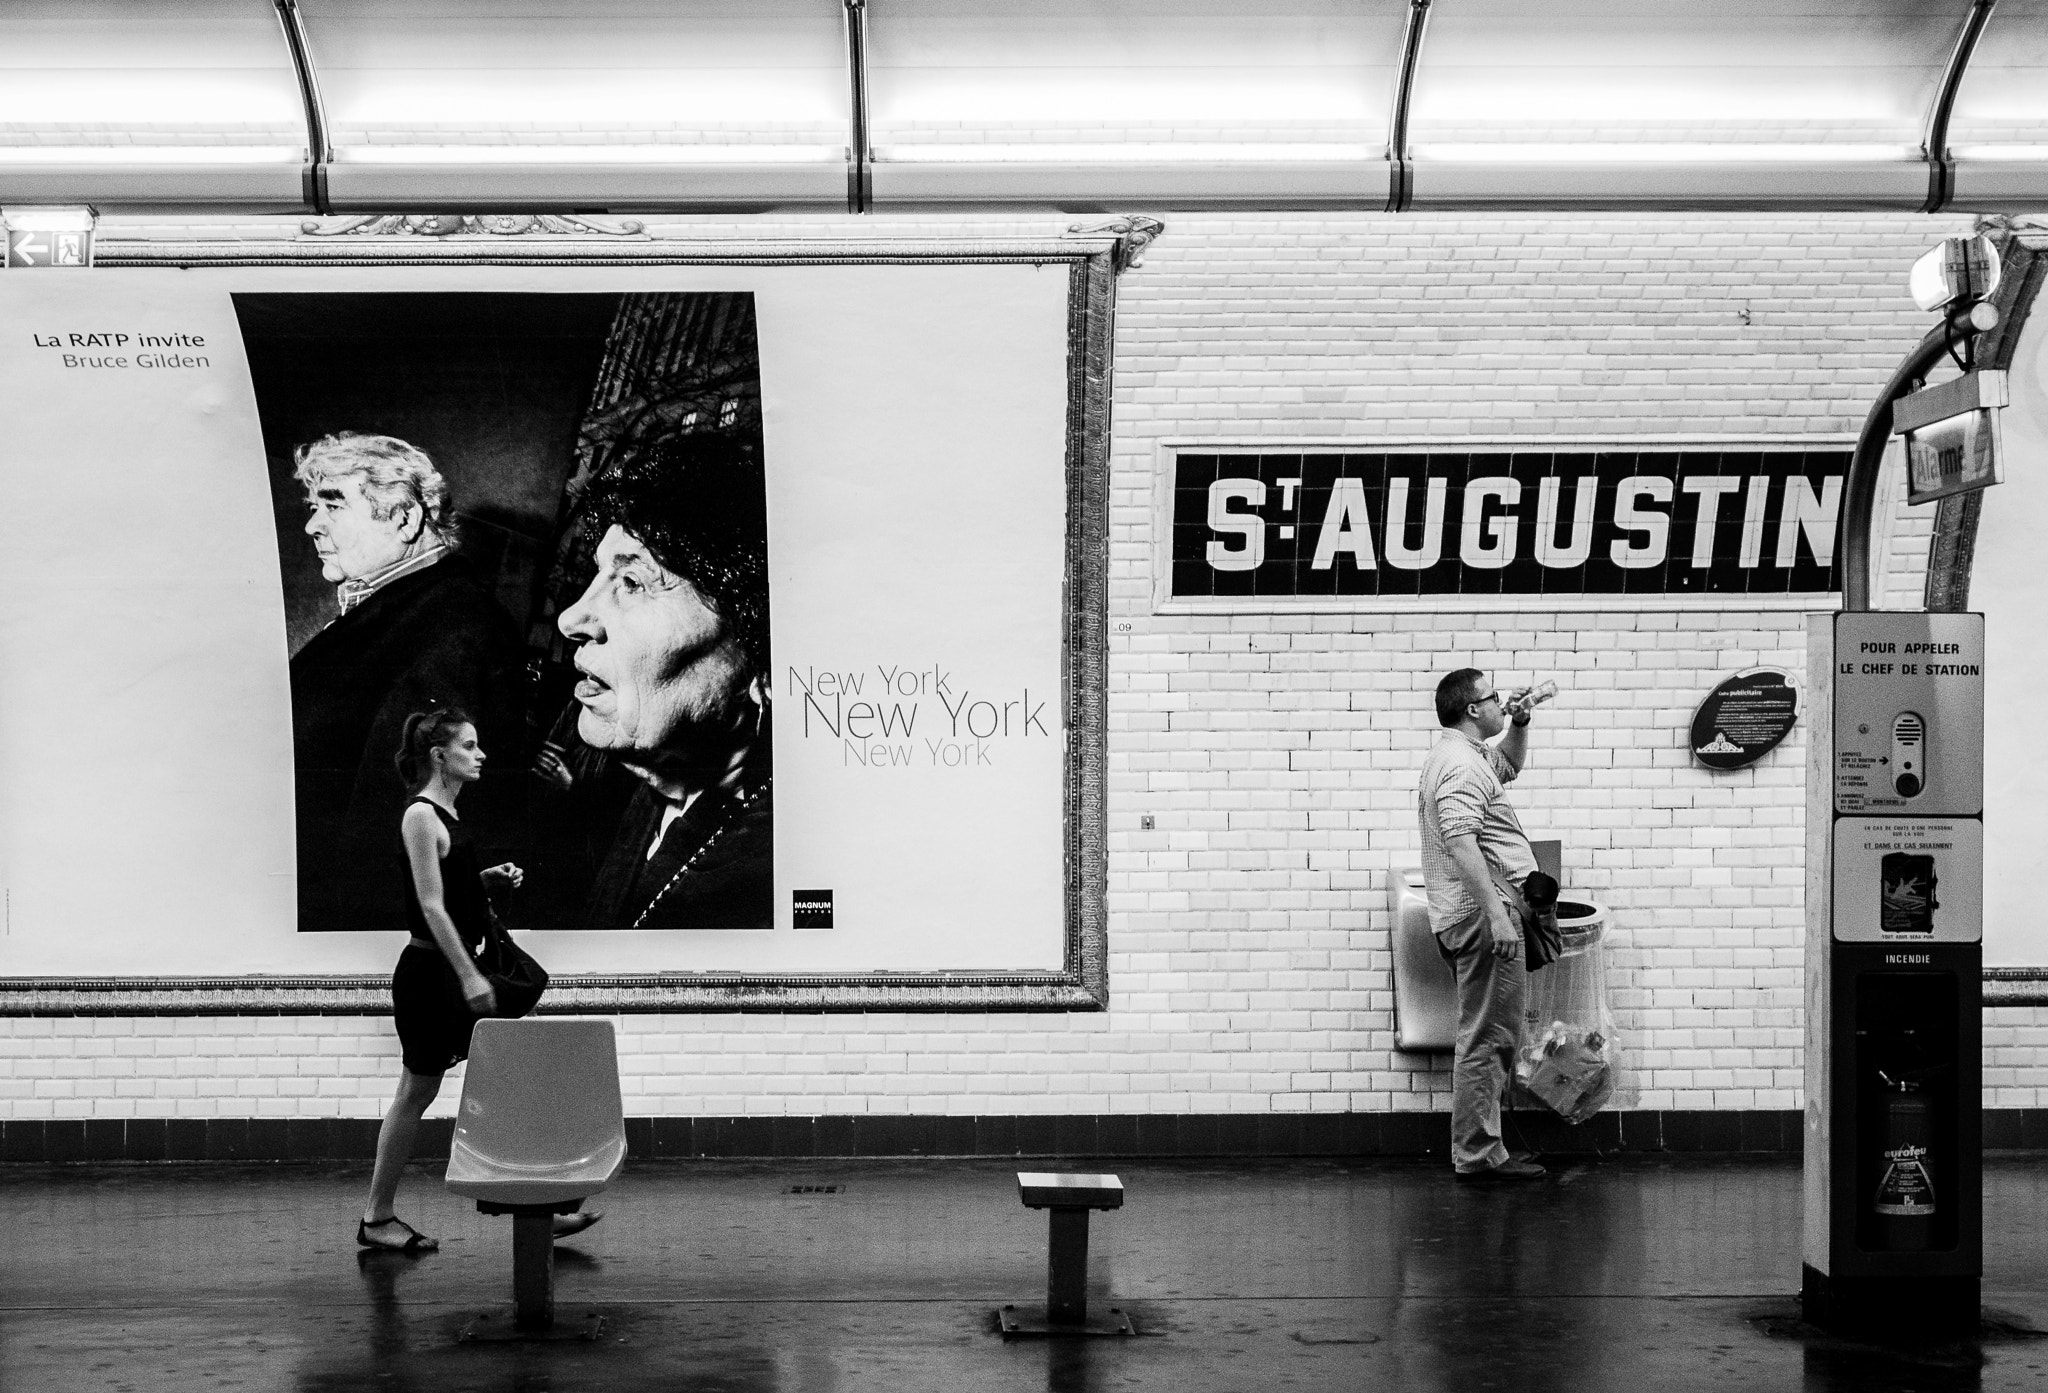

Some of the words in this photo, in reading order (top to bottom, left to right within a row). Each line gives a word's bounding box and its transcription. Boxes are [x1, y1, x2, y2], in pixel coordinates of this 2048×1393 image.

[33, 333, 62, 347] La
[68, 333, 129, 347] RATP
[138, 333, 206, 347] invite
[62, 354, 129, 368] Bruce
[136, 353, 210, 368] Gilden
[1311, 475, 1845, 571] AUGUSTIN
[1118, 623, 1132, 631] 09
[1860, 642, 1896, 654] POUR
[1904, 643, 1960, 655] APPELER
[1840, 663, 1854, 674] LE
[1862, 663, 1894, 675] CHEF
[1902, 664, 1918, 675] DE
[1925, 665, 1979, 676] STATION
[789, 665, 865, 697] New
[878, 663, 952, 695] York
[1729, 689, 1763, 697] publicitaire
[804, 691, 918, 738] New
[938, 688, 1049, 738] York
[844, 738, 913, 767] New
[925, 737, 992, 767] York
[794, 901, 831, 909] MAGNUM
[1885, 954, 1931, 964] INCENDIE
[1884, 1145, 1927, 1158] eurofeu
